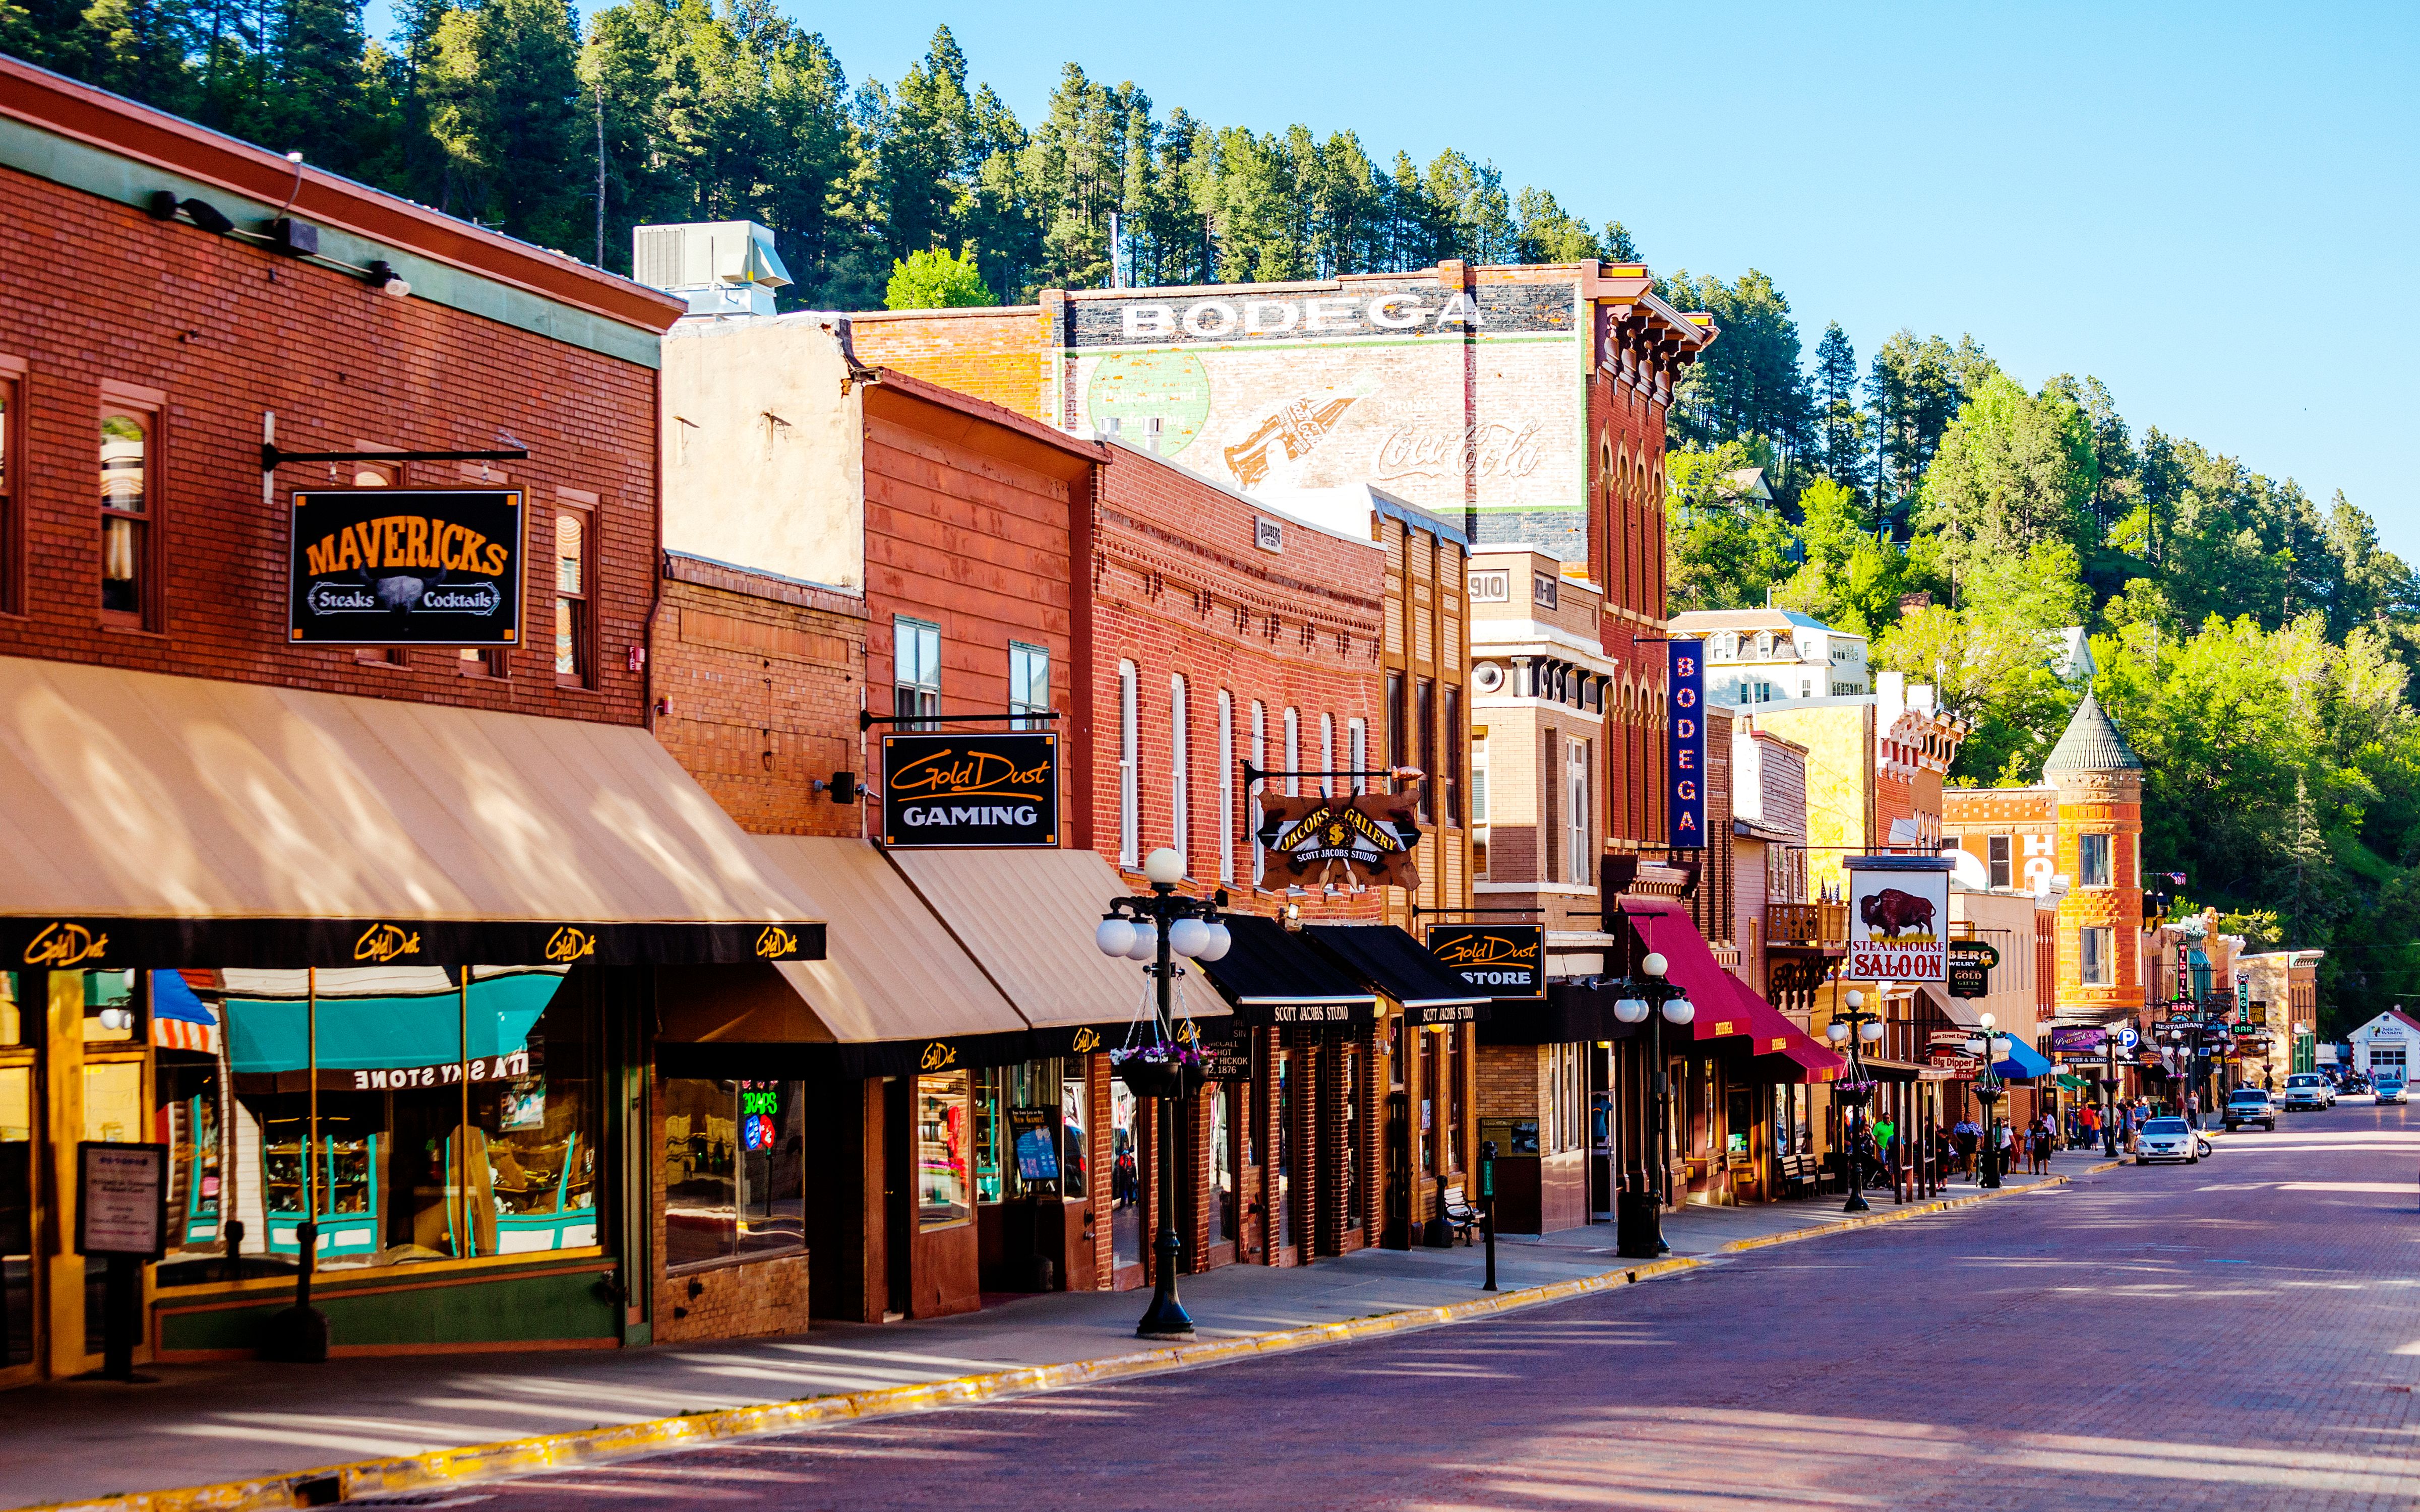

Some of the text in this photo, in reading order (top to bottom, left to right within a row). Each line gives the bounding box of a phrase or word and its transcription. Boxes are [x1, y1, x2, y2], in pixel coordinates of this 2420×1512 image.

[1122, 293, 1486, 338] BODEGA
[1102, 387, 1197, 404] Delicious and
[1261, 522, 1280, 544] GOLDBERG
[306, 515, 508, 577] MAVERICKS
[1468, 576, 1505, 598] 910
[319, 591, 492, 608] Steaks Cocktails
[1676, 657, 1696, 831] BODEGA
[890, 749, 1051, 791] Gold Dust
[903, 806, 1038, 827] GAMING
[1281, 807, 1398, 851] JACOBS GALLERY
[1297, 849, 1377, 863] SCOTT JACOBS STUDIO
[24, 921, 109, 967] Gold Dust
[354, 923, 420, 962] Gold Dust
[546, 926, 596, 962] Gold Dust
[756, 926, 798, 958] Gold Dust
[1434, 934, 1539, 962] Gold Dust
[1853, 940, 1945, 952] STEAKHOUSE
[1949, 950, 1992, 960] BERG
[2179, 944, 2187, 970] WILD
[1854, 954, 1942, 978] SALOON
[1461, 972, 1532, 985] STORE
[1275, 1005, 1348, 1021] SCOTT JACOBS STUDIO
[1423, 1009, 1438, 1022] SCOTT
[1458, 1006, 1473, 1020] STUDIO
[2172, 1002, 2195, 1011] BAR
[1715, 1021, 1733, 1036] BODEGA
[2155, 1022, 2204, 1030] RESTAURANT
[1073, 1027, 1100, 1053] Gold Dust
[1772, 1037, 1786, 1050] BODEGA
[2054, 1031, 2091, 1047] Peacock's
[2123, 1031, 2135, 1046] P
[921, 1042, 956, 1070] Gold Dust
[1933, 1057, 1972, 1069] Big Dipper
